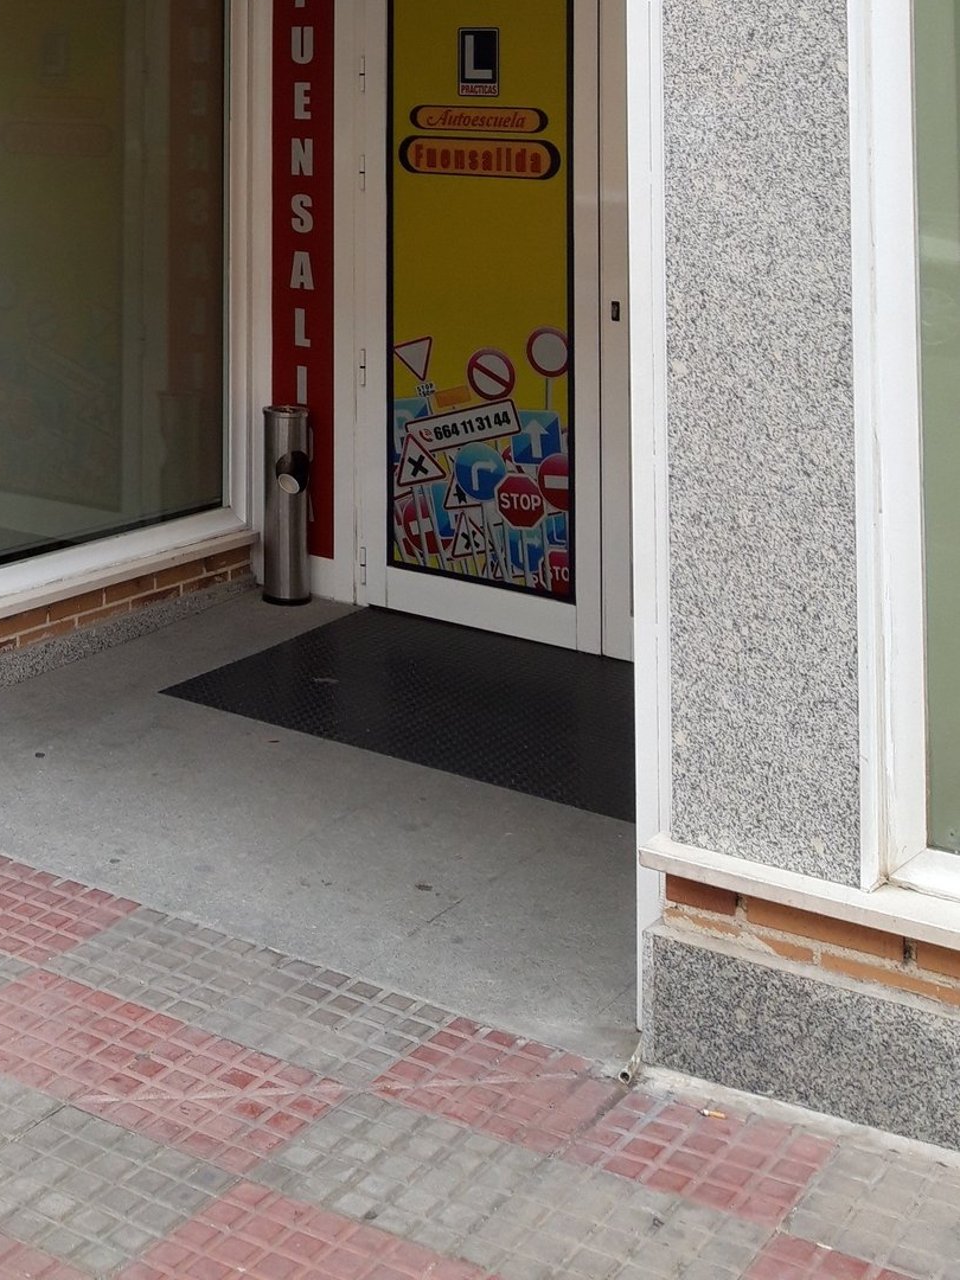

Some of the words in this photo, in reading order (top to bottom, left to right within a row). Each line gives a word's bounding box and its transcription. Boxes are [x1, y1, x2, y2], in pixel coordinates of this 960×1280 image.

[464, 34, 493, 79] L
[461, 85, 497, 95] PRACTICAS
[426, 109, 527, 129] Autoescuela
[415, 144, 541, 173] Fuensalida
[433, 422, 460, 440] 664
[460, 419, 474, 434] 11
[475, 415, 492, 431] 31
[493, 411, 511, 426] 44
[500, 493, 541, 511] STOP
